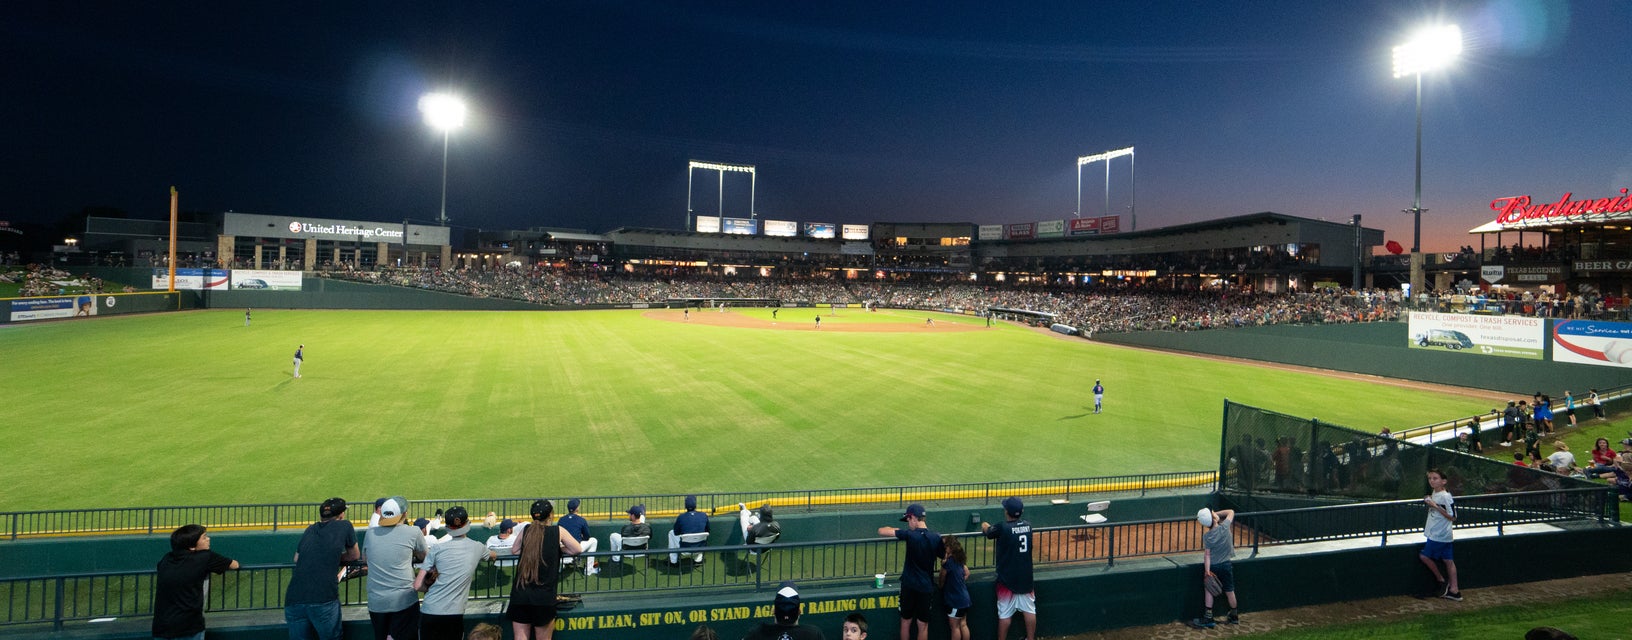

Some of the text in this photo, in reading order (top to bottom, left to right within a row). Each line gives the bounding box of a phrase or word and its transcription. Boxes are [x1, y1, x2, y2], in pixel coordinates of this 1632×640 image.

[302, 223, 403, 238] United Heritage Center
[1575, 261, 1612, 270] BEER
[1442, 315, 1472, 323] COMPOST
[1480, 317, 1502, 325] TRASH
[1504, 318, 1538, 327] SERVICES
[1585, 325, 1619, 334] Service
[1481, 334, 1537, 344] texasdisposal.com
[1019, 534, 1028, 553] 3
[568, 616, 595, 631] NOT
[598, 614, 636, 629] LEAN,
[640, 612, 661, 627] SIT
[664, 611, 686, 625] ON,
[689, 609, 707, 622] OR
[710, 606, 750, 621] STAND
[808, 599, 857, 614] RAILING
[859, 597, 876, 610] OR
